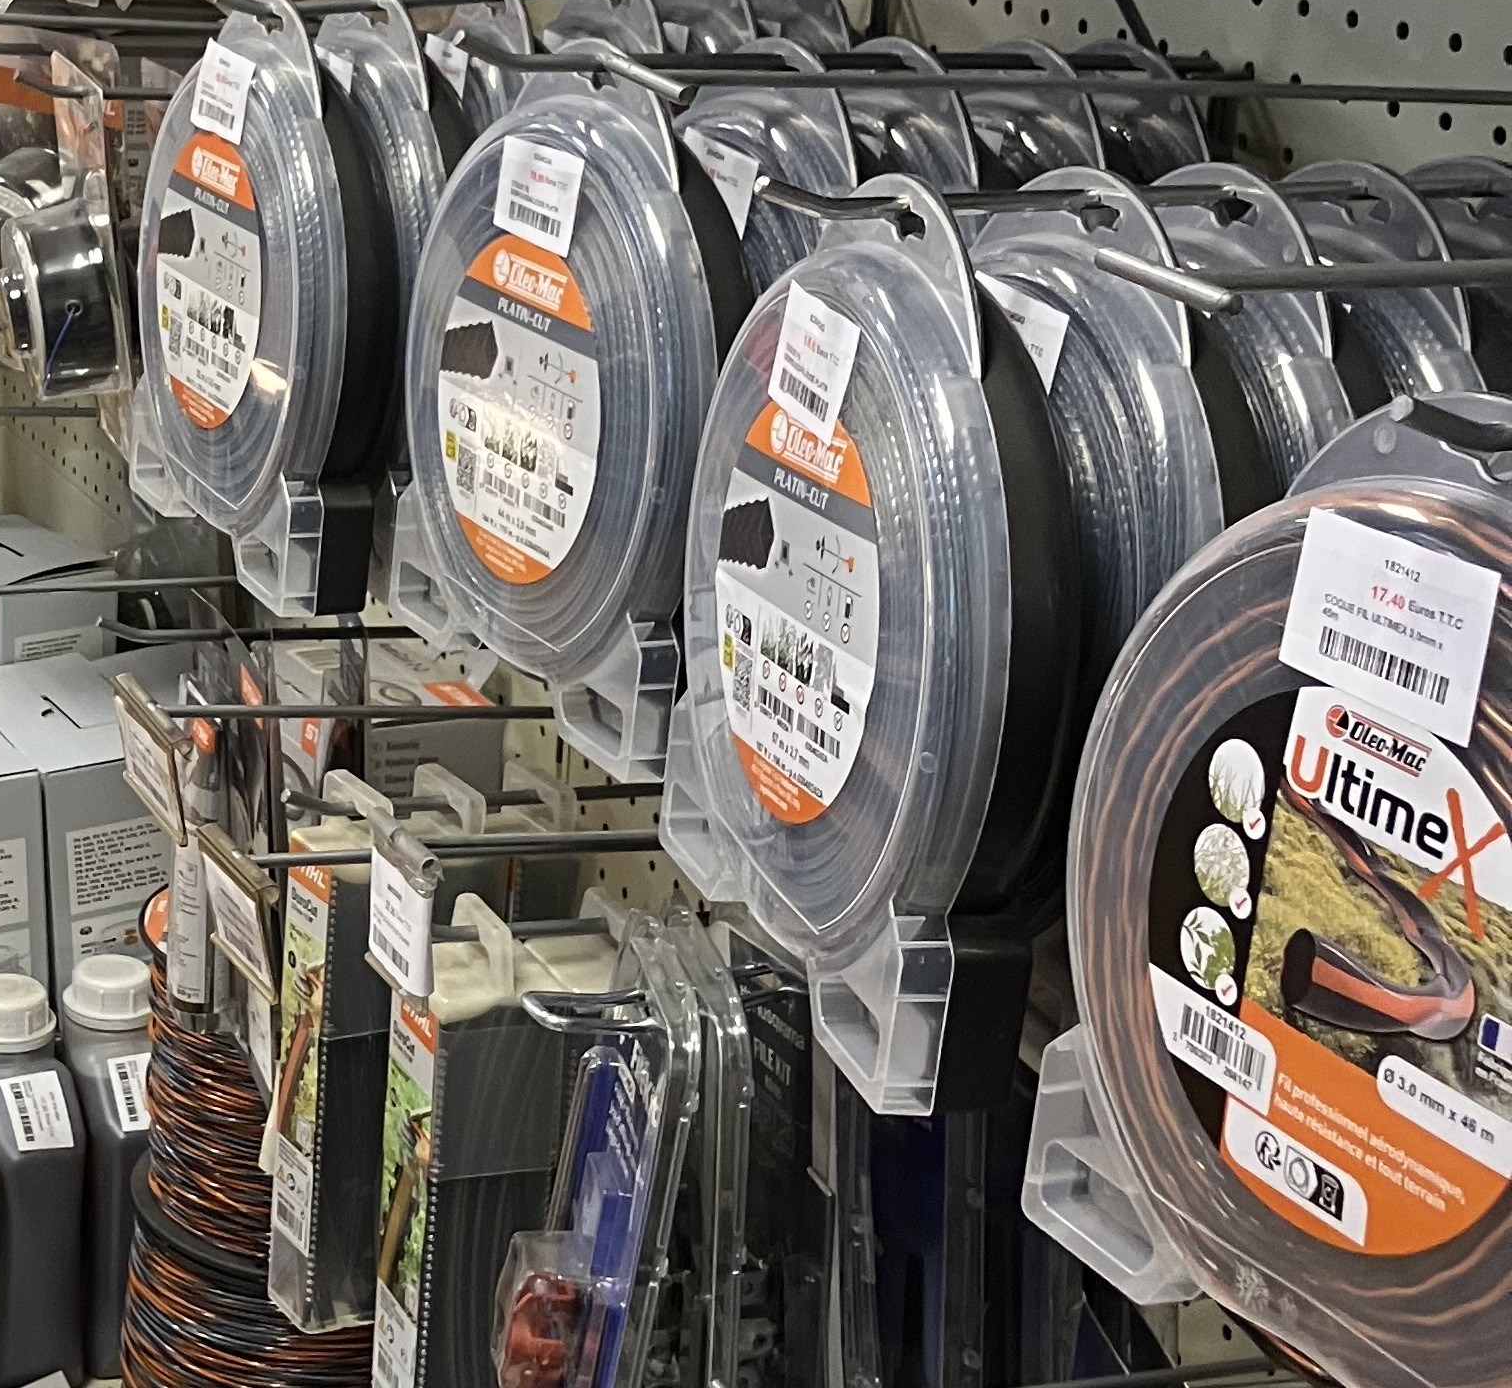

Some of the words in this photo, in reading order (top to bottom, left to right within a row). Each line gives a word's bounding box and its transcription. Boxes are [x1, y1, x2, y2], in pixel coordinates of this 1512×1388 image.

[509, 262, 564, 306] Oleo-Mac
[497, 297, 552, 333] PLATIN-CUT
[788, 425, 844, 475] Oleo-Mac
[773, 467, 830, 510] PLATIN-CUT
[1384, 559, 1421, 584] 1821412
[1371, 585, 1406, 610] 17,40
[1408, 600, 1436, 620] Euros
[1349, 720, 1427, 773] Oleo-Mac
[296, 865, 326, 890] TIHL
[1205, 1005, 1247, 1041] 1821412
[1278, 1072, 1291, 1092] Fil
[1291, 1083, 1369, 1140] professionnel
[1419, 1091, 1445, 1116] mm
[1447, 1108, 1457, 1122] x
[1480, 1127, 1496, 1145] m
[1305, 1112, 1364, 1160] résistance
[1364, 1152, 1377, 1170] et
[1377, 1159, 1403, 1186] tout
[1403, 1174, 1446, 1213] terrain
